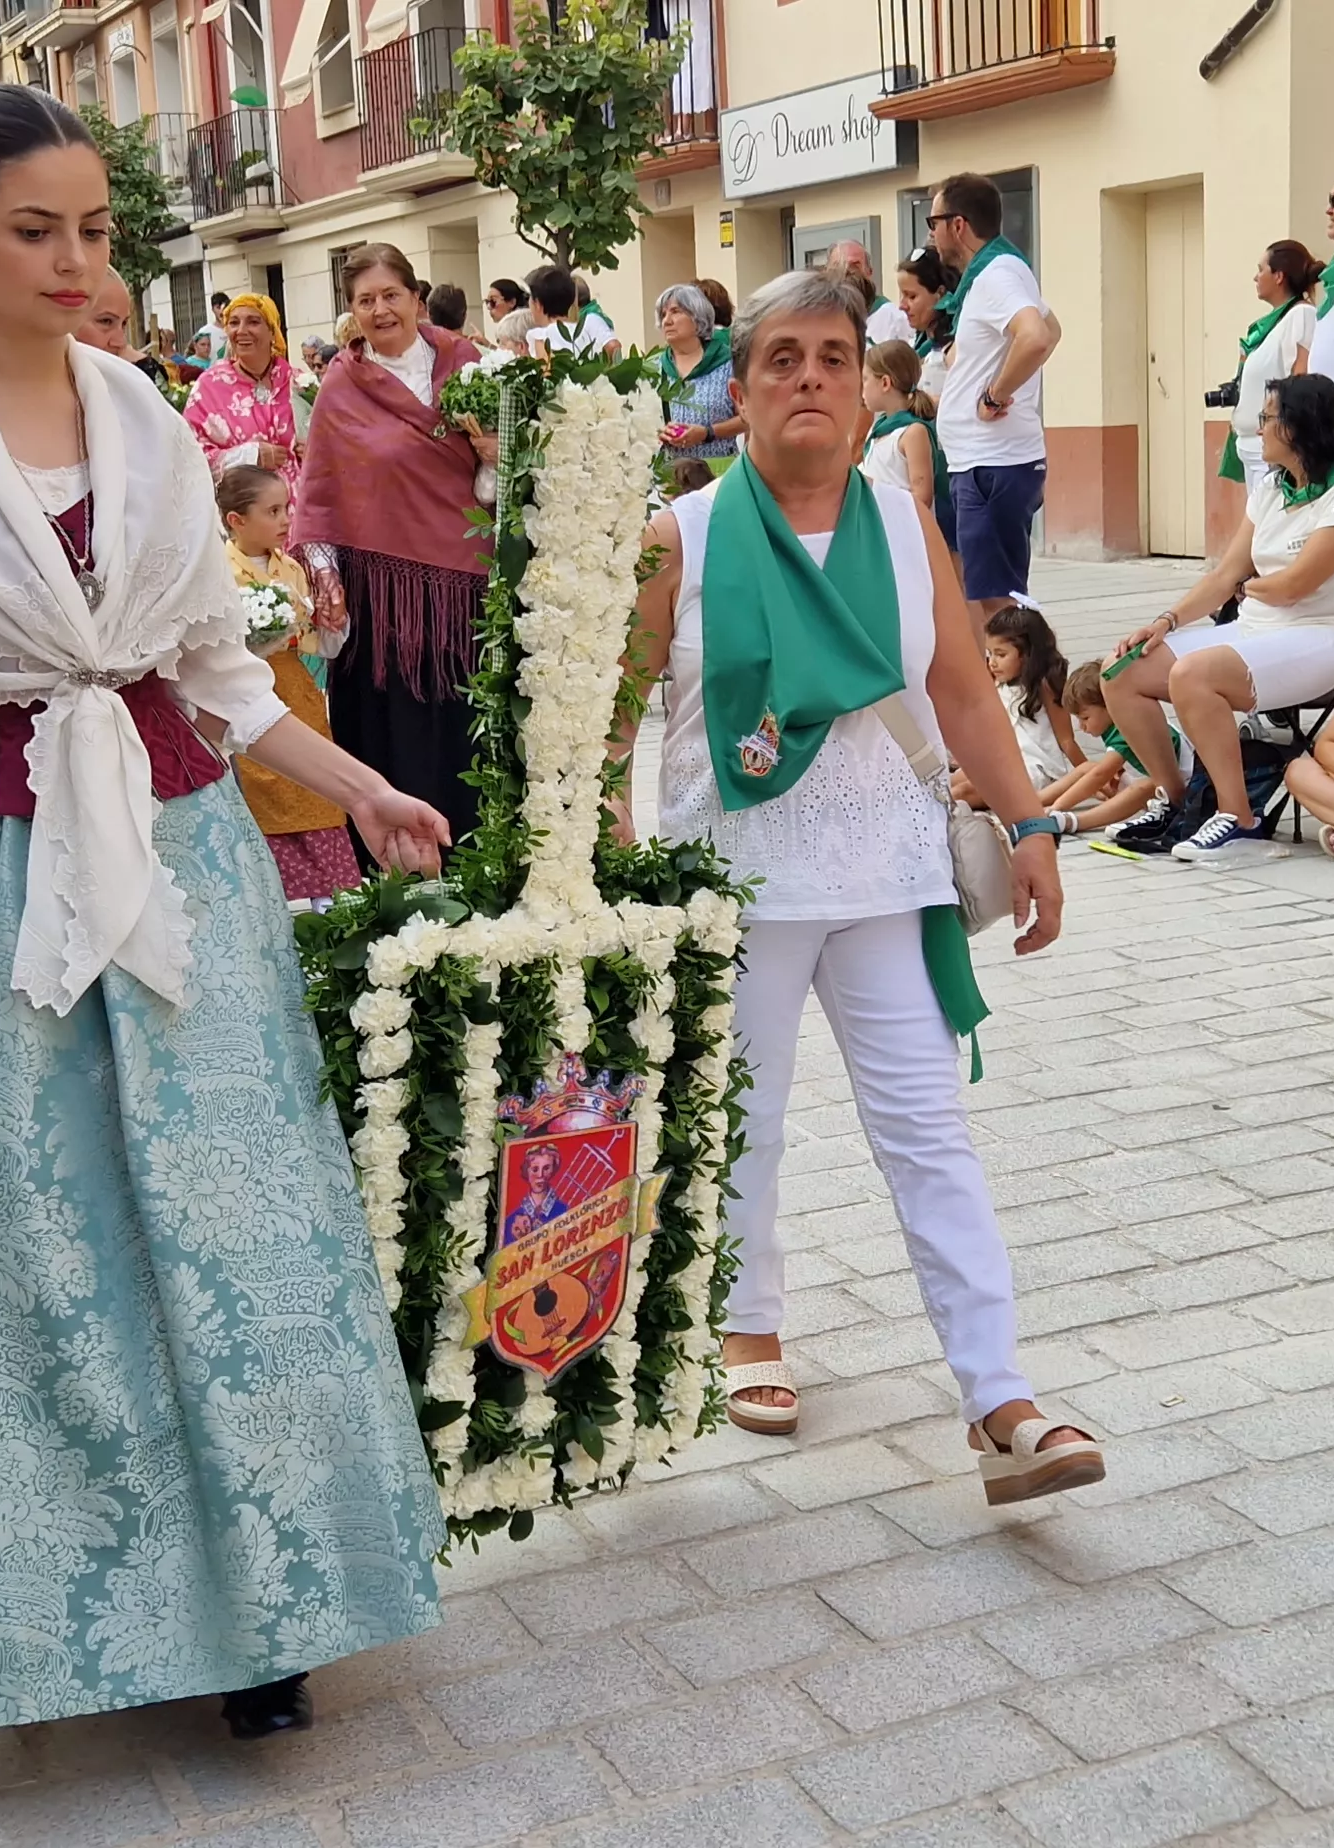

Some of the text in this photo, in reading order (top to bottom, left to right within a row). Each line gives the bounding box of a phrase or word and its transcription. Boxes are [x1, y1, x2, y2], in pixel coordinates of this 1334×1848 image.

[771, 93, 882, 163] Dream shop
[495, 1195, 630, 1290] SAN LORENZO
[517, 1229, 549, 1252] GRUPO
[551, 1245, 589, 1271] HUESCA
